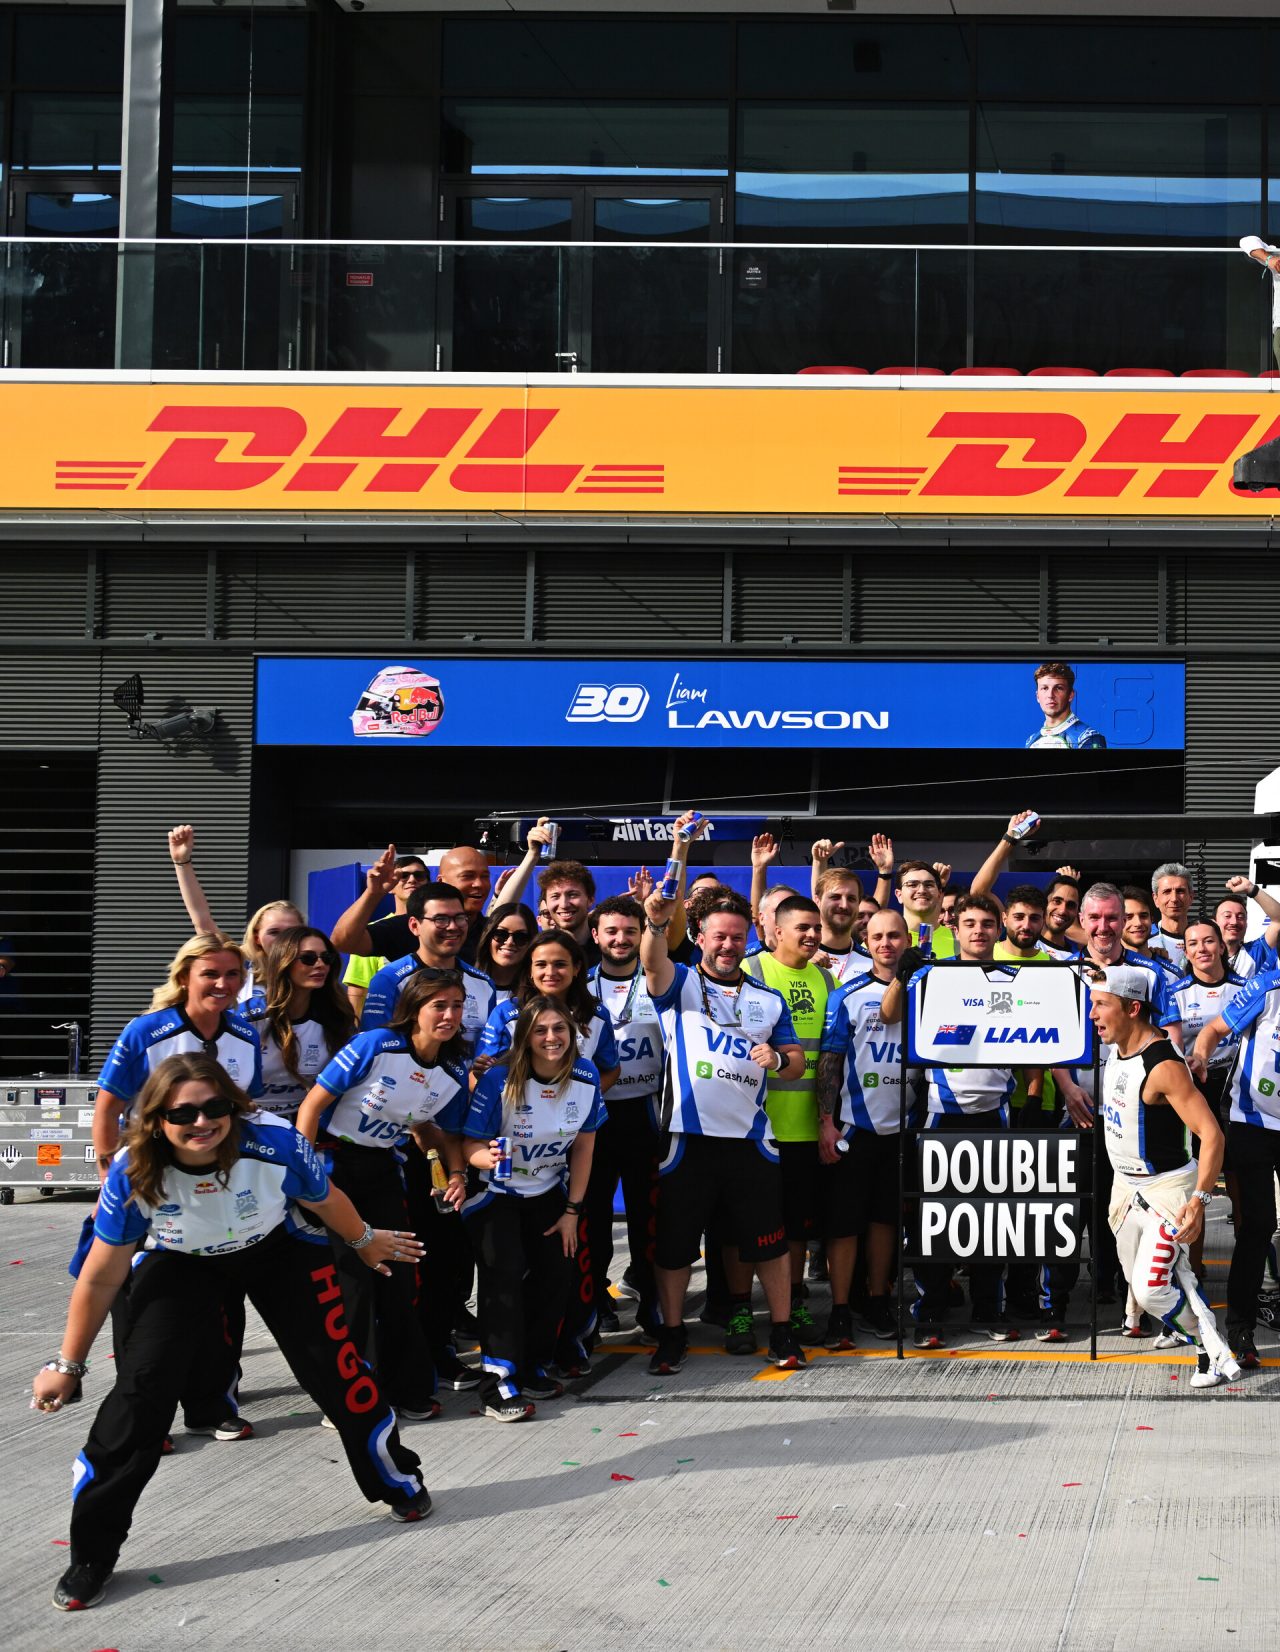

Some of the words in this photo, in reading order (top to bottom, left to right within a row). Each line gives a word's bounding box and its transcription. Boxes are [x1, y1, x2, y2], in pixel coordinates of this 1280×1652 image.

[136, 406, 584, 492] DHL
[666, 673, 708, 708] Liam
[566, 683, 650, 723] 30
[391, 709, 417, 724] Red
[418, 706, 439, 720] Bull
[668, 710, 889, 730] LAWSON
[609, 819, 715, 841] Airtasr
[1133, 958, 1154, 967] HUGO
[844, 981, 864, 993] HUGO
[962, 998, 984, 1006] VISA
[240, 1007, 262, 1019] HUGO
[508, 1009, 519, 1017] HU
[151, 1022, 175, 1038] HUGO
[231, 1022, 253, 1037] HUGO
[984, 1027, 1060, 1043] LIAM
[382, 1040, 400, 1048] HUGO
[615, 1037, 654, 1062] ISA
[701, 1026, 753, 1061] VIS
[866, 1042, 902, 1064] VIS
[572, 1067, 593, 1079] HUGO
[616, 1075, 635, 1086] ash
[638, 1072, 656, 1084] App
[717, 1068, 743, 1081] Cash
[744, 1075, 759, 1087] App
[882, 1077, 903, 1086] Cas
[362, 1097, 384, 1112] Mobil
[369, 1091, 388, 1103] TUDOR
[1112, 1097, 1126, 1108] HUGO
[1104, 1104, 1122, 1128] ISA
[513, 1130, 533, 1139] Mobil
[246, 1140, 275, 1156] HUGO
[923, 1138, 1077, 1194] DOUBLE
[77, 1173, 99, 1181] ZARG
[236, 1189, 252, 1198] VISA
[757, 1227, 787, 1248] HUG
[921, 1201, 1076, 1258] POINTS
[157, 1234, 183, 1244] Mobil
[577, 1215, 593, 1304] UGO
[1148, 1224, 1175, 1287] HUG
[310, 1264, 379, 1413] HUGO
